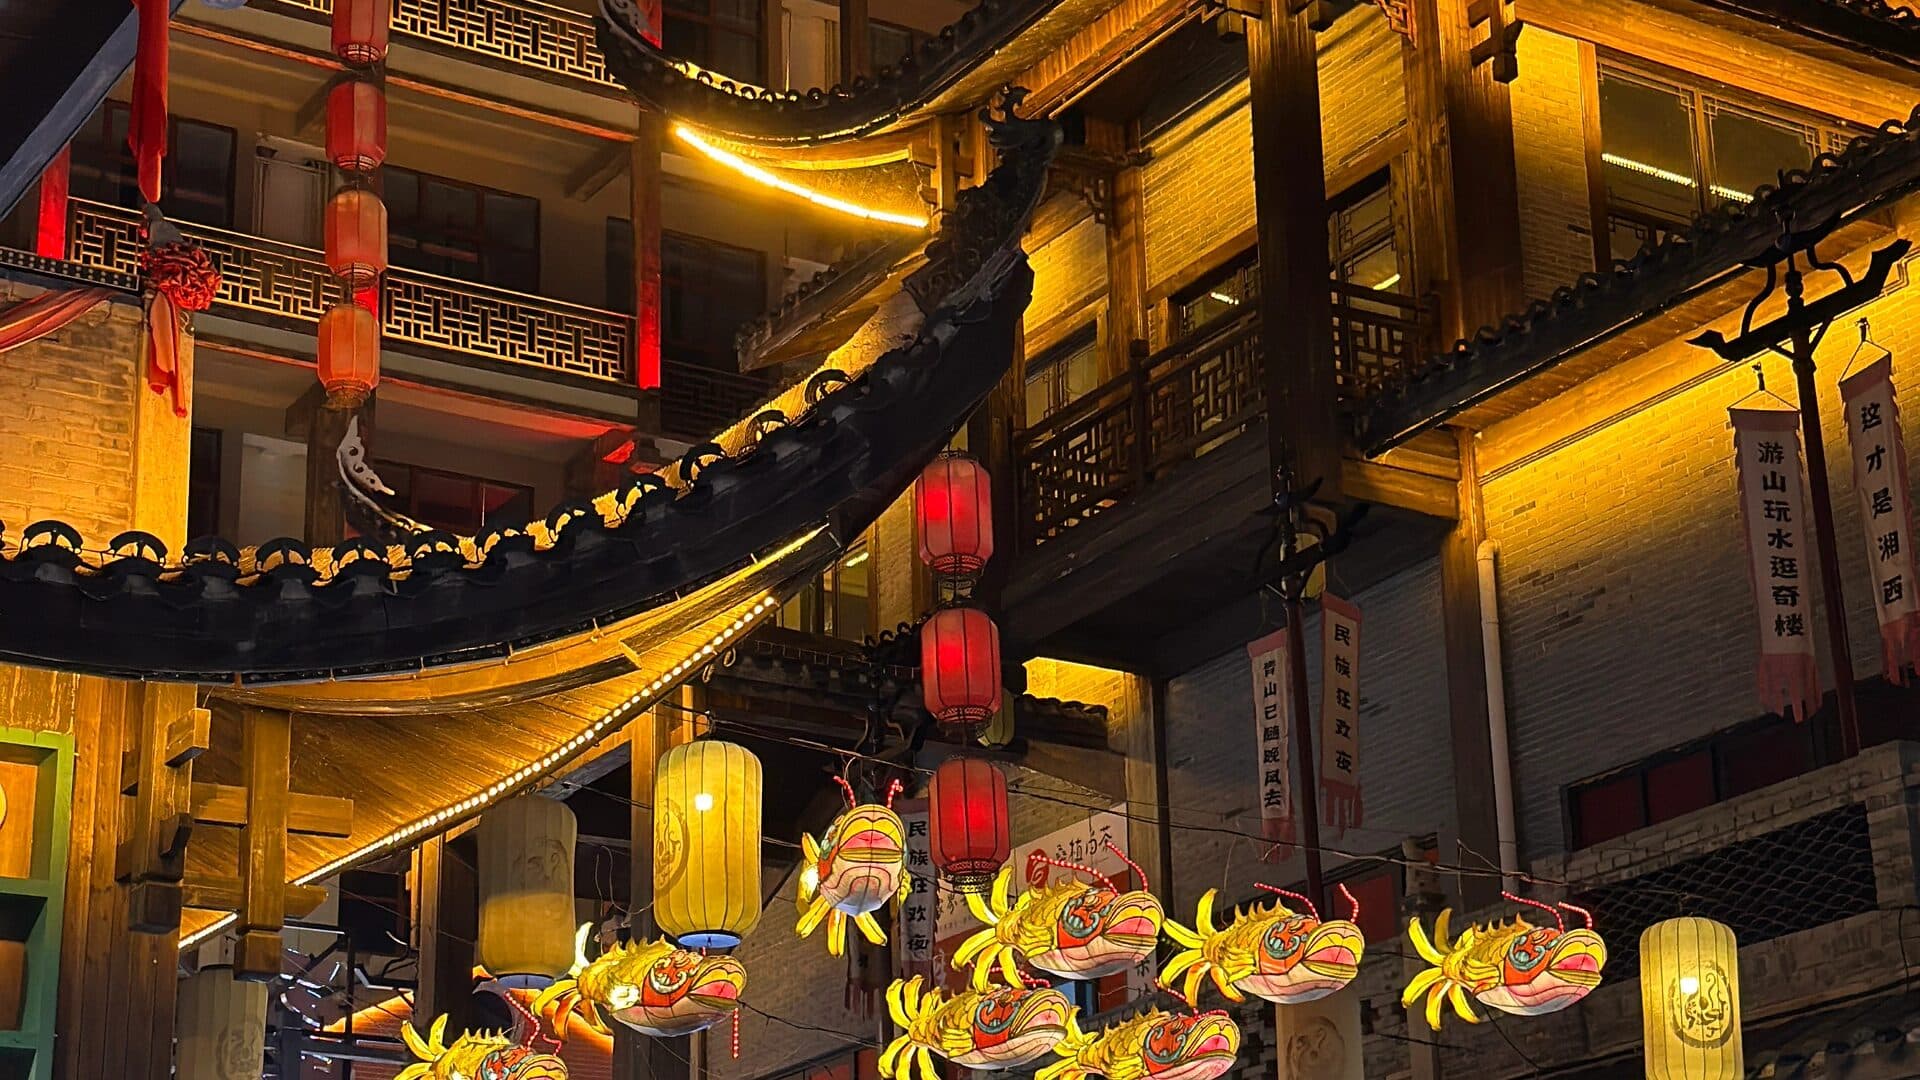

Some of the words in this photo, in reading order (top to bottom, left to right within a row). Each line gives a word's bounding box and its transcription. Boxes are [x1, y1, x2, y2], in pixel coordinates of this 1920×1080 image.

[1758, 441, 1804, 637] 游山玩水逛奇楼
[1860, 403, 1903, 605] 这才是湘西
[1334, 623, 1352, 775] 民族狂欢夜
